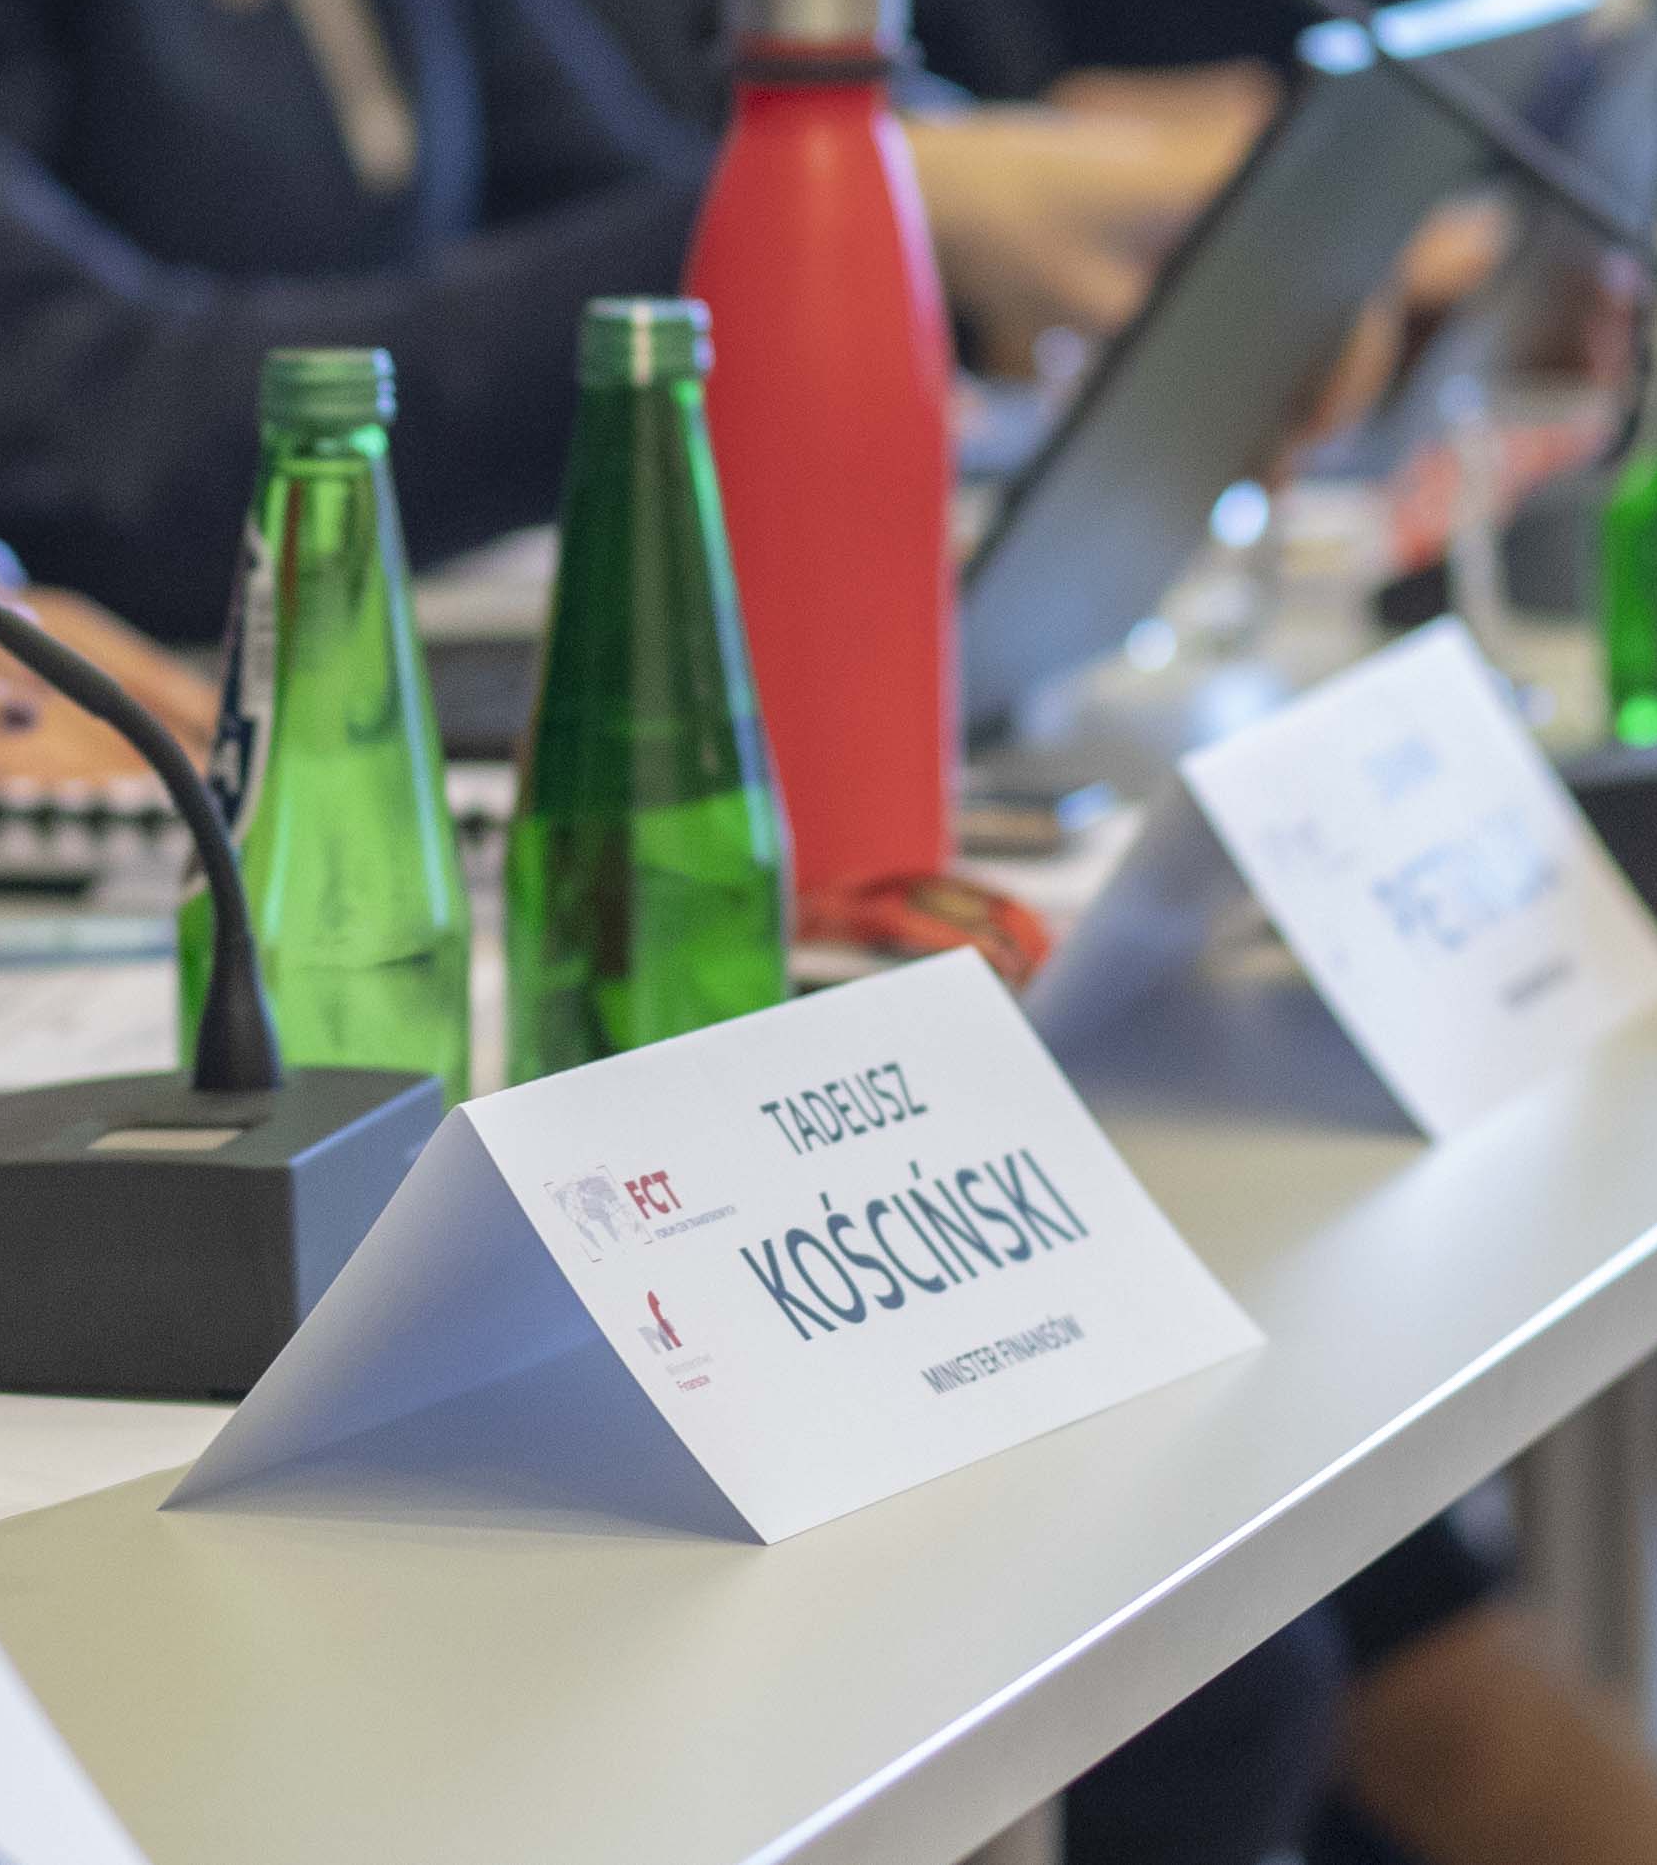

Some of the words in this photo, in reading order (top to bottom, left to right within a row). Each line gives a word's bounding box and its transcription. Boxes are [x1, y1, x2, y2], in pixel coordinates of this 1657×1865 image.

[760, 1062, 928, 1155] TADEUSZ
[624, 1170, 682, 1220] FCT
[739, 1148, 1089, 1341] KOŚCIŃSKI
[920, 1346, 1006, 1395] MINISTER
[994, 1313, 1085, 1366] FINANSÓW
